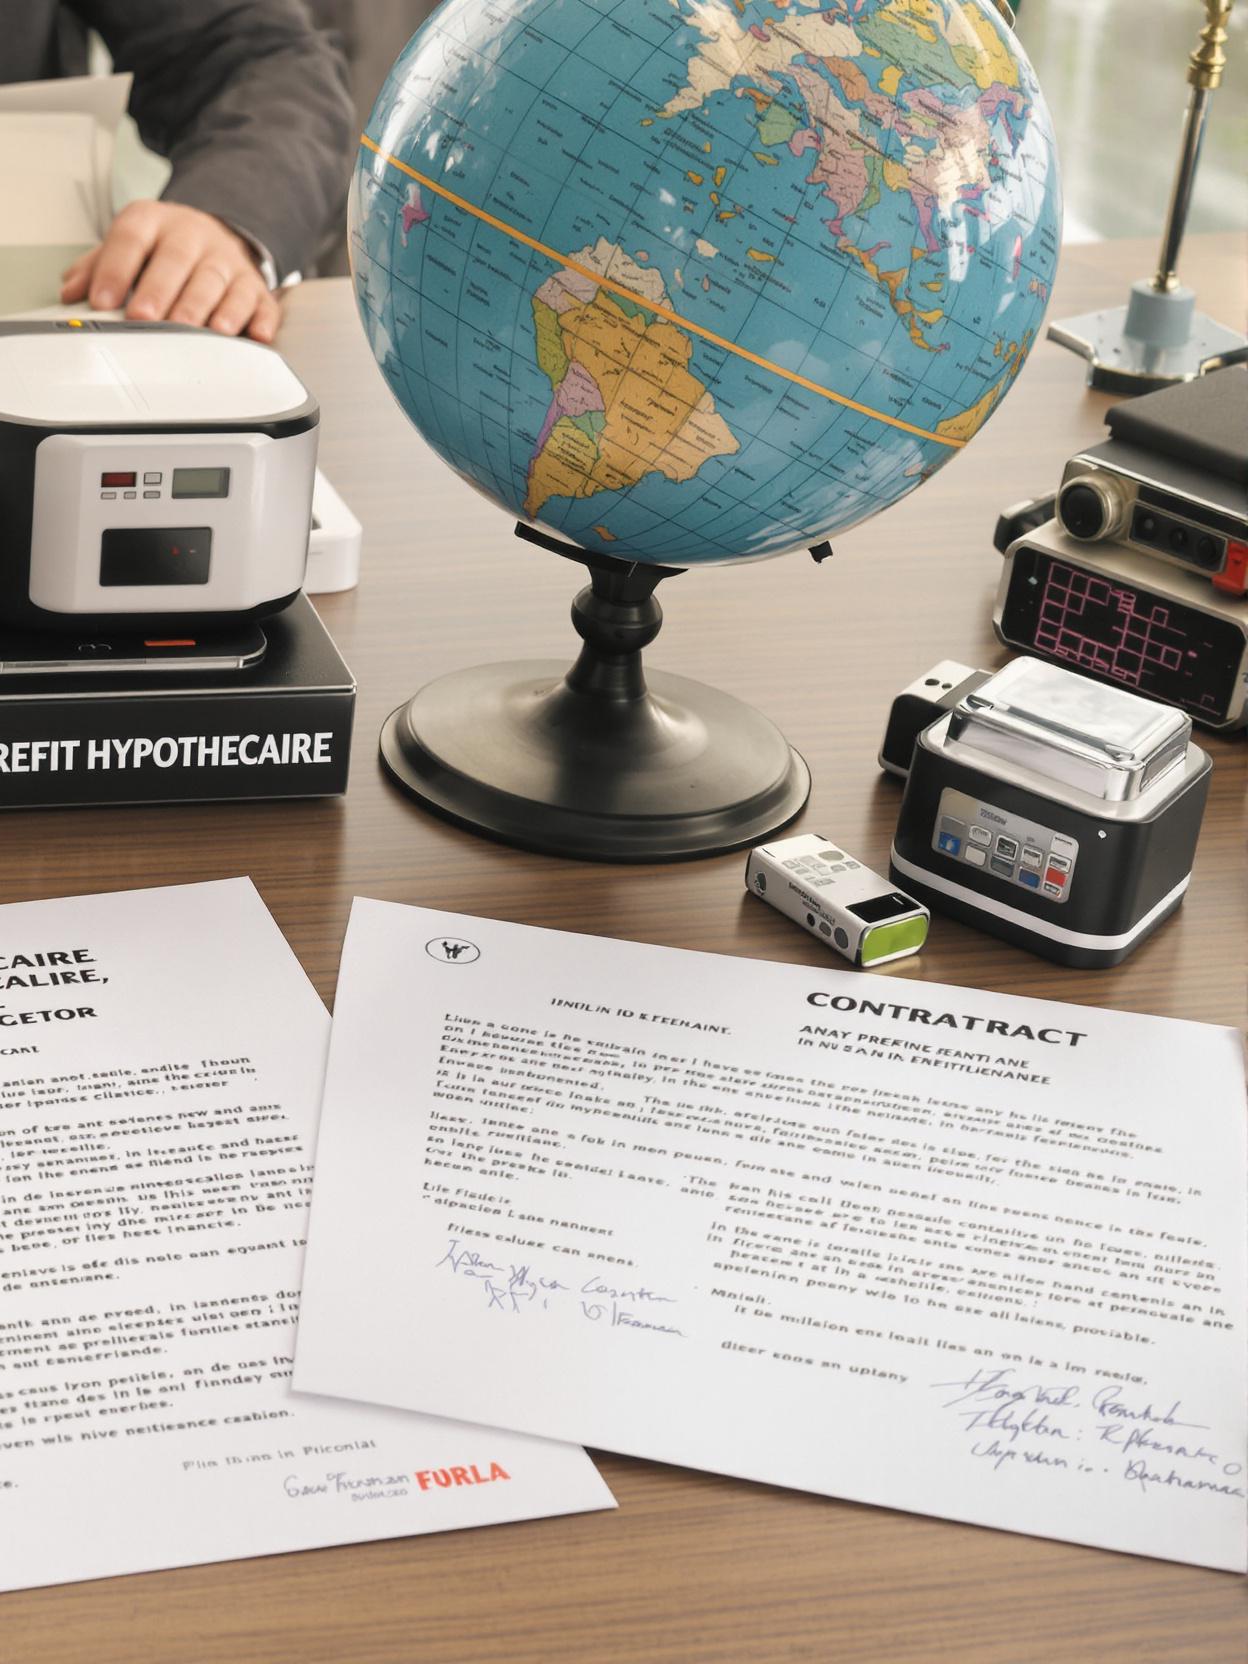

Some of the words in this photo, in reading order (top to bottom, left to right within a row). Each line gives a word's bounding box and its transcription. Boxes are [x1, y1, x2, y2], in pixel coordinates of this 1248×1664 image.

[87, 732, 333, 770] HYPOTHECAIRE
[805, 991, 1089, 1048] CONTRATRACT
[414, 1462, 511, 1491] FURLA
